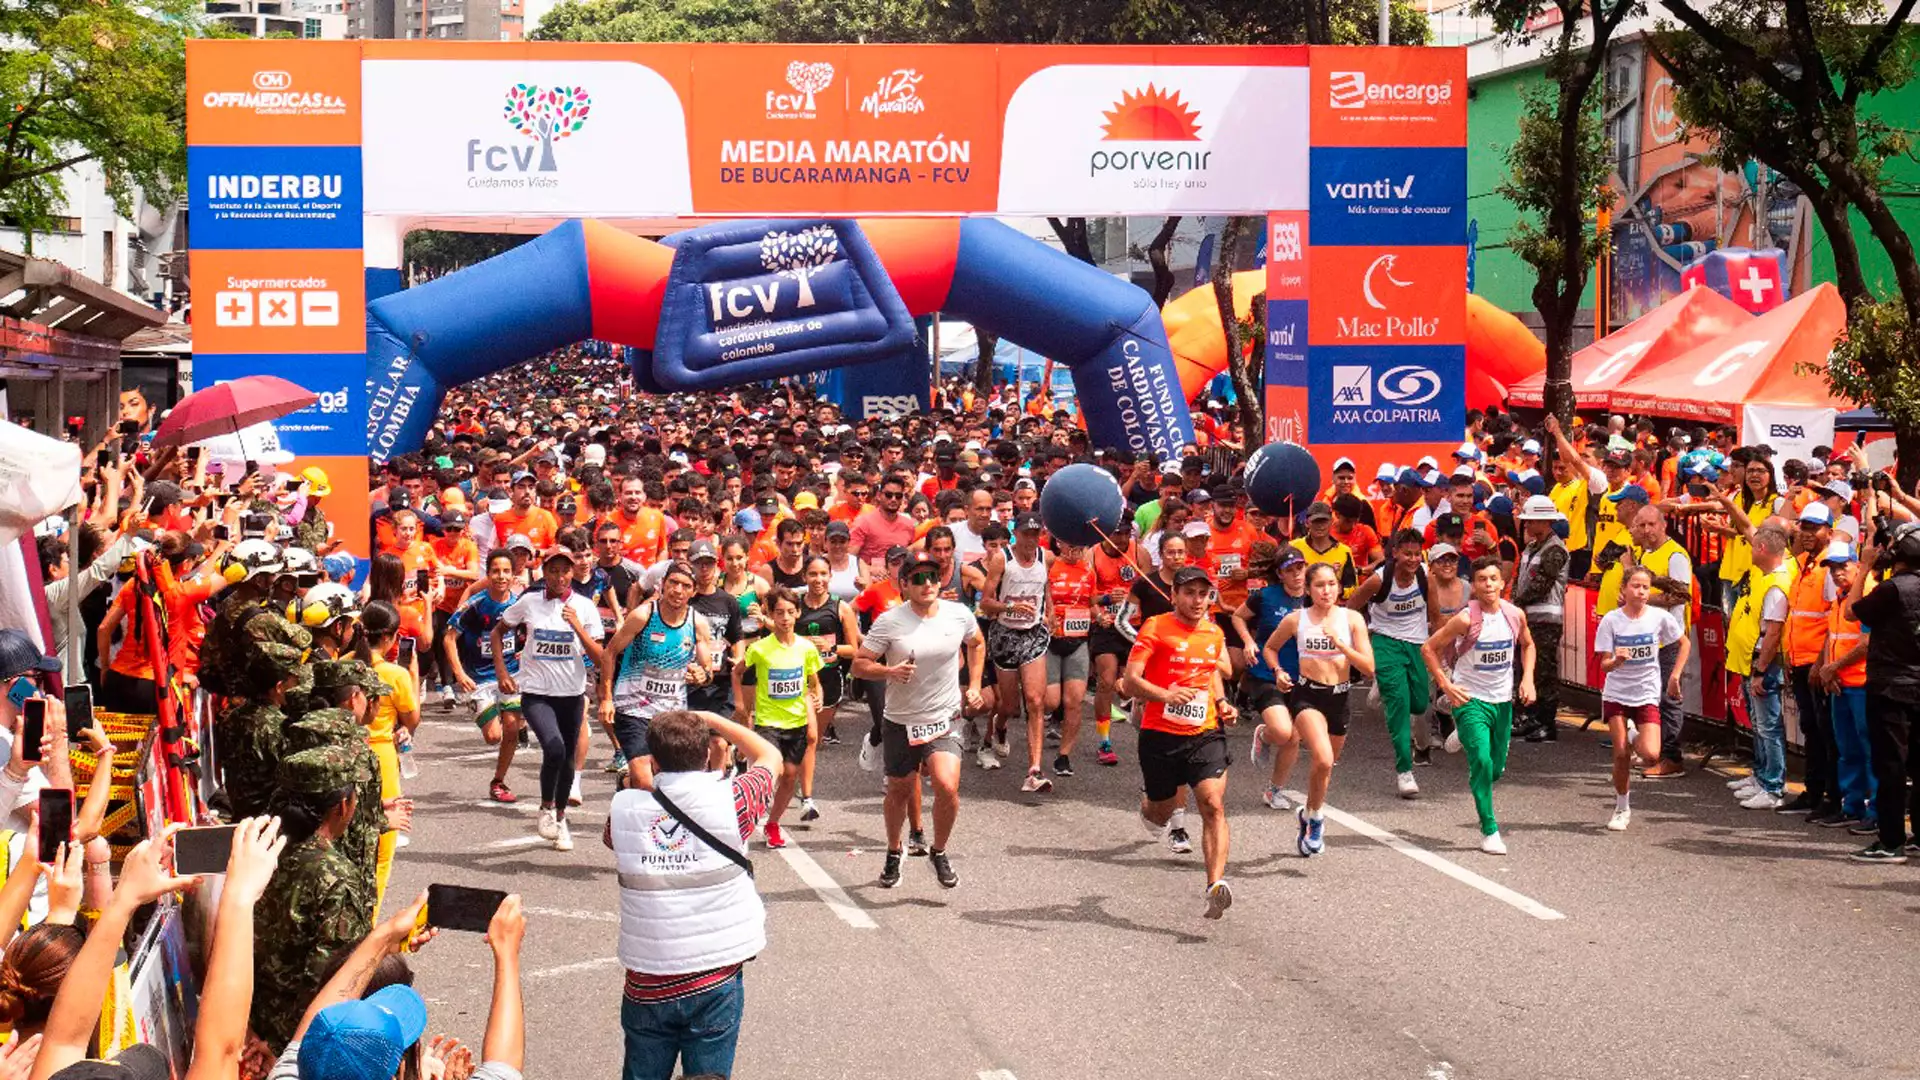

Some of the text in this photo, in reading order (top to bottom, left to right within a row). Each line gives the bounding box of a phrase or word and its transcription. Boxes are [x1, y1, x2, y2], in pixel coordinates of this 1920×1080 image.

[259, 74, 283, 87] OM
[203, 92, 323, 107] OFFIMEDICAS
[766, 91, 802, 110] fcv
[1367, 83, 1452, 105] encarga
[468, 139, 535, 172] fcv
[721, 133, 970, 163] MEDIA MARATÓN
[1091, 150, 1212, 178] porvenir
[467, 176, 559, 189] Cuidamos Vidas
[720, 168, 745, 183] DE
[752, 167, 911, 183] BUCARAMANGA
[932, 168, 970, 183] FCV
[208, 174, 342, 199] INDERBU
[1326, 178, 1390, 199] vanti
[1348, 204, 1452, 214] Más formas de avanzar
[226, 276, 327, 291] Supermercados
[708, 281, 780, 322] fcv
[715, 318, 773, 336] fundación
[718, 320, 823, 348] cardiovascular de
[1335, 316, 1436, 338] Mac Pollo
[721, 342, 775, 361] colombia
[1692, 340, 1770, 387] G
[1123, 339, 1170, 465] CARDIOVASC
[1333, 386, 1364, 401] AXA
[862, 394, 920, 420] ESSA
[1108, 365, 1146, 454] DE COLO
[1149, 363, 1184, 462] FUNDACIO
[1332, 408, 1441, 424] AXA COLPATRIA
[371, 386, 421, 466] LOMBIA
[1769, 423, 1805, 439] ESSA
[536, 642, 571, 656] 22486
[1480, 651, 1507, 664] 4658
[1629, 646, 1652, 659] 263
[911, 721, 946, 738] 55575
[641, 853, 699, 865] PUNTUAL
